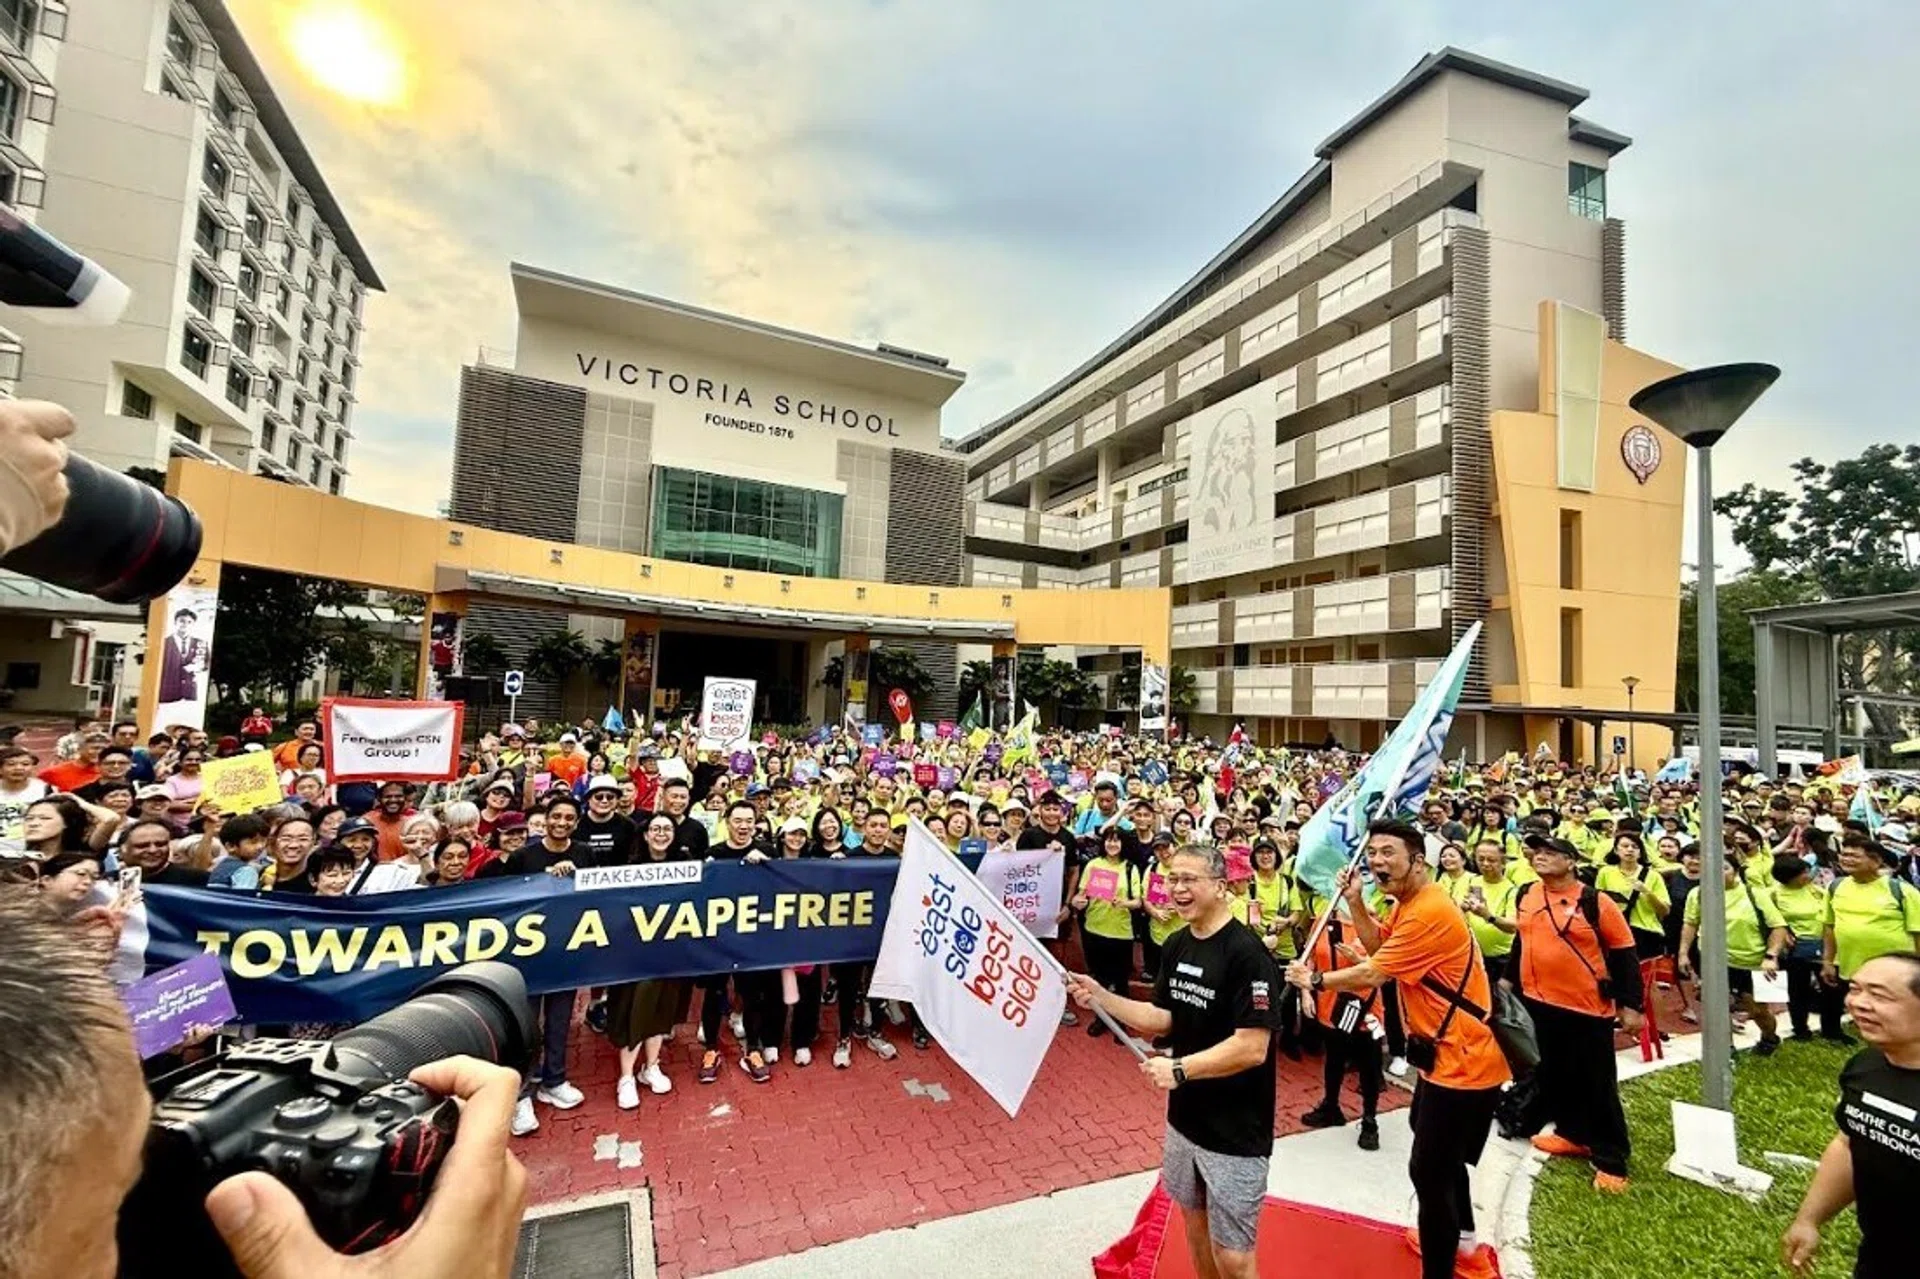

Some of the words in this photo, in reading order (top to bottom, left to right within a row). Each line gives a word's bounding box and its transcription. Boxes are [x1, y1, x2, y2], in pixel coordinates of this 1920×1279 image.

[577, 353, 752, 408] VICTORIA
[774, 395, 900, 437] SCHOOL
[705, 413, 765, 434] FOUNDED
[768, 426, 794, 440] 1876
[714, 688, 747, 700] east
[712, 699, 743, 712] side
[710, 711, 745, 724] best
[709, 724, 740, 736] side
[416, 735, 441, 744] CSN
[364, 747, 411, 758] Group
[580, 865, 698, 885] #TAKEASTAND
[1006, 864, 1042, 879] east
[1004, 879, 1038, 895] side
[1004, 894, 1041, 909] best
[921, 873, 956, 956] east
[1012, 908, 1037, 923] ide
[195, 912, 547, 979] TOWARDS
[566, 909, 609, 951] A
[630, 891, 874, 942] VAPE-FREE
[945, 906, 982, 980] side
[964, 919, 1013, 1005] best
[1002, 955, 1042, 1028] side
